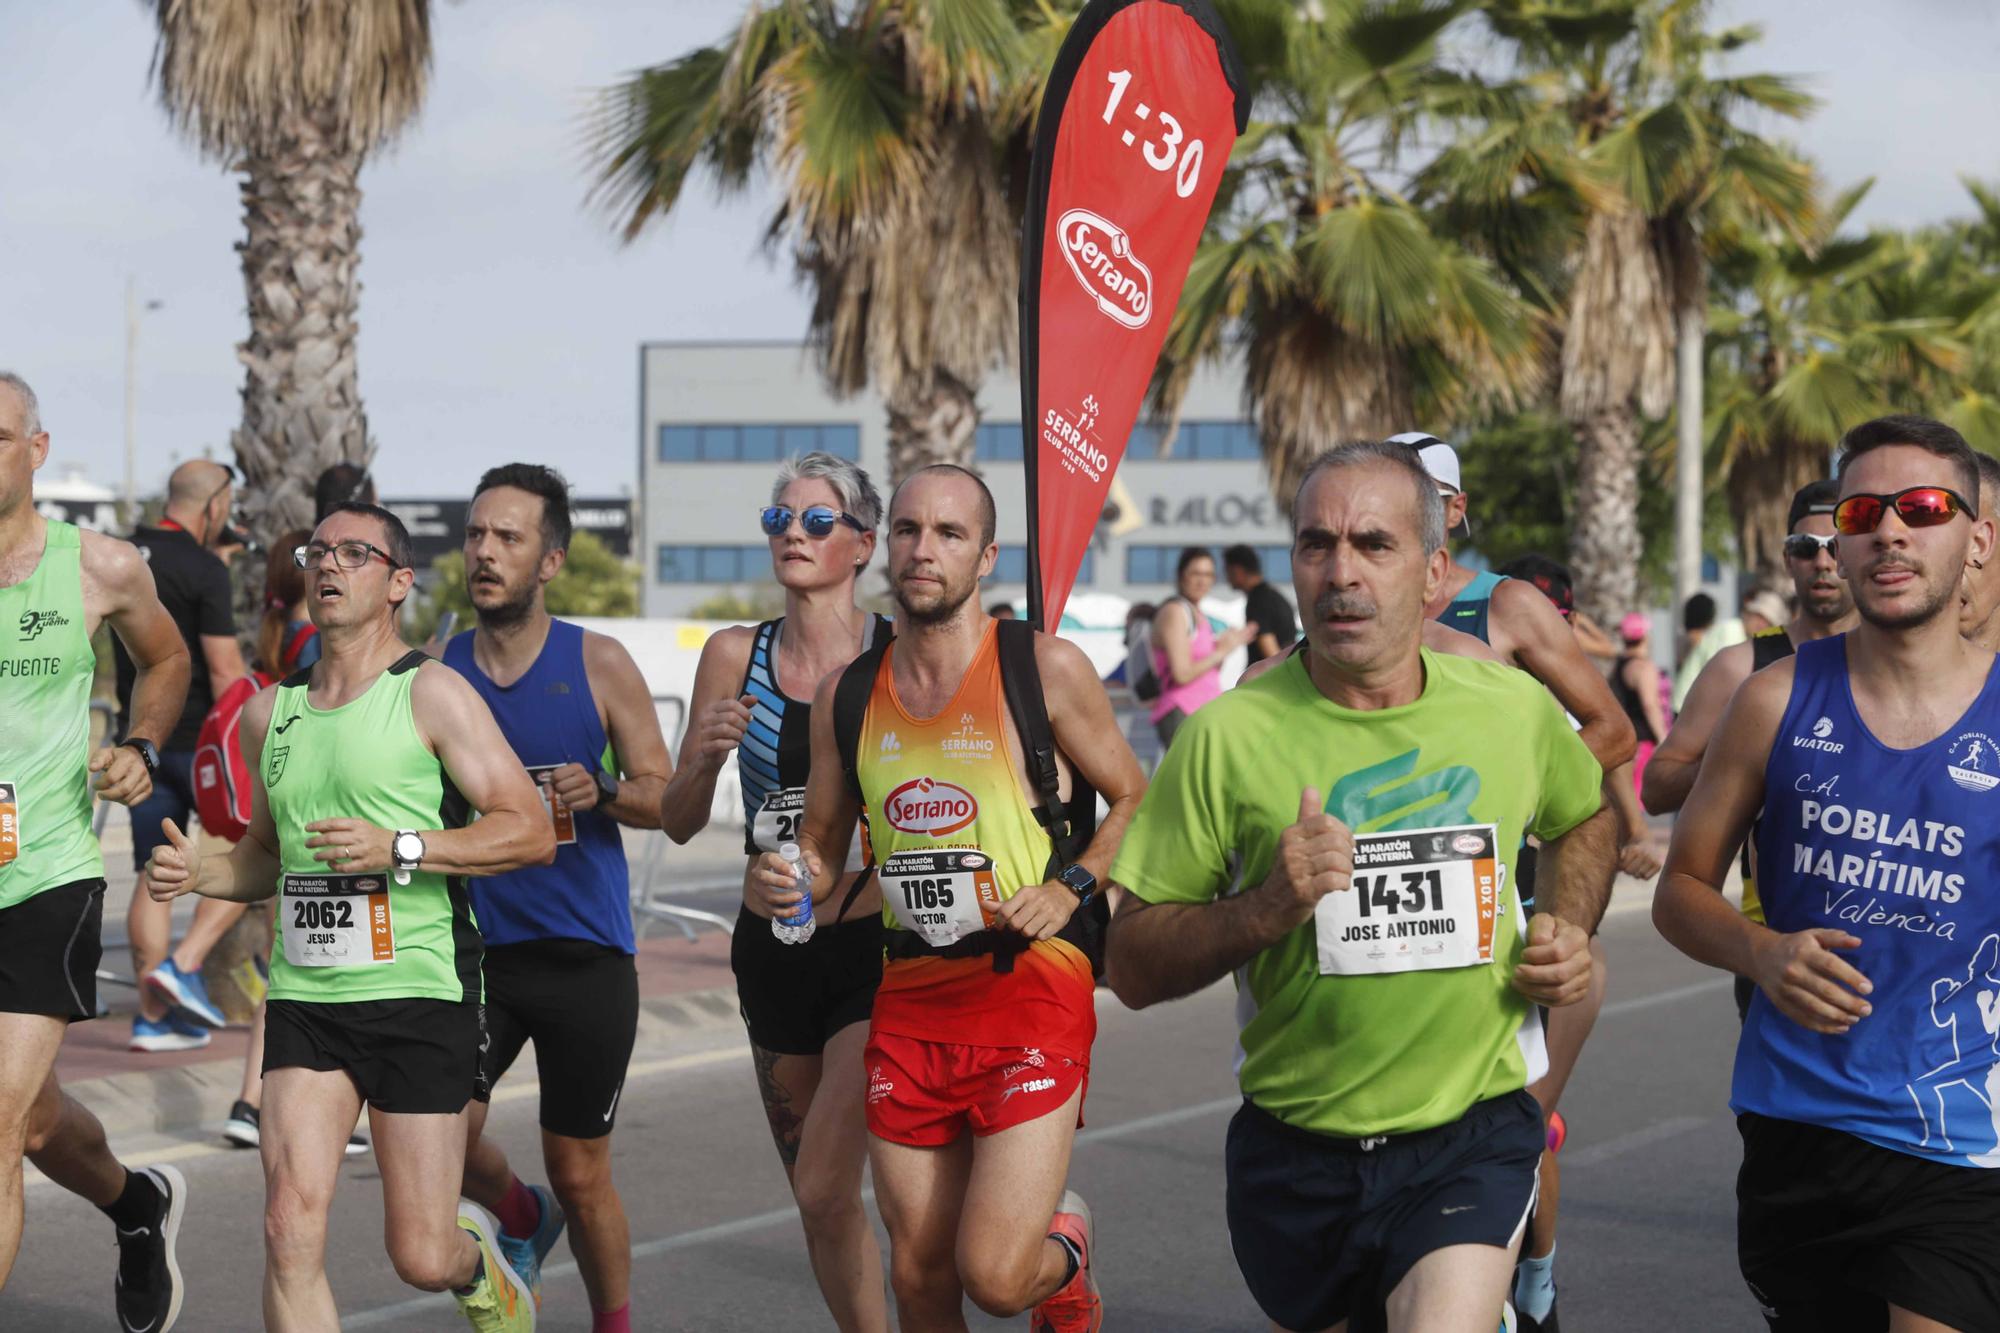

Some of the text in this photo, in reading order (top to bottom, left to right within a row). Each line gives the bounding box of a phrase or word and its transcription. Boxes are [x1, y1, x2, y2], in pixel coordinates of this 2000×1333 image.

[1102, 69, 1203, 198] 1:30
[1069, 223, 1147, 313] Serrano
[1044, 408, 1108, 473] SERRANO
[1043, 429, 1100, 483] CLUB ATLETISMO
[941, 739, 994, 752] SERRANO
[1793, 736, 1845, 755] VIATOR
[1794, 773, 1841, 798] C.A.
[892, 797, 970, 822] Serrano
[2, 813, 13, 843] BOX 2
[1802, 799, 1966, 857] POBLATS
[902, 856, 934, 865] MARATÓN
[1354, 853, 1369, 865] DE
[1369, 850, 1415, 862] PATERNA
[1360, 839, 1411, 855] MARATÓN
[885, 863, 936, 873] VILA DE PATERNA
[1793, 843, 1966, 904] MARÍTIMS
[900, 877, 955, 910] 1165
[1353, 869, 1444, 918] 1431
[1479, 875, 1492, 919] BOX 2
[294, 900, 354, 930] 2062
[374, 904, 386, 925] BOX
[1824, 888, 1958, 941] València
[306, 933, 336, 944] JESUS
[1340, 917, 1456, 943] JOSE ANTONIO
